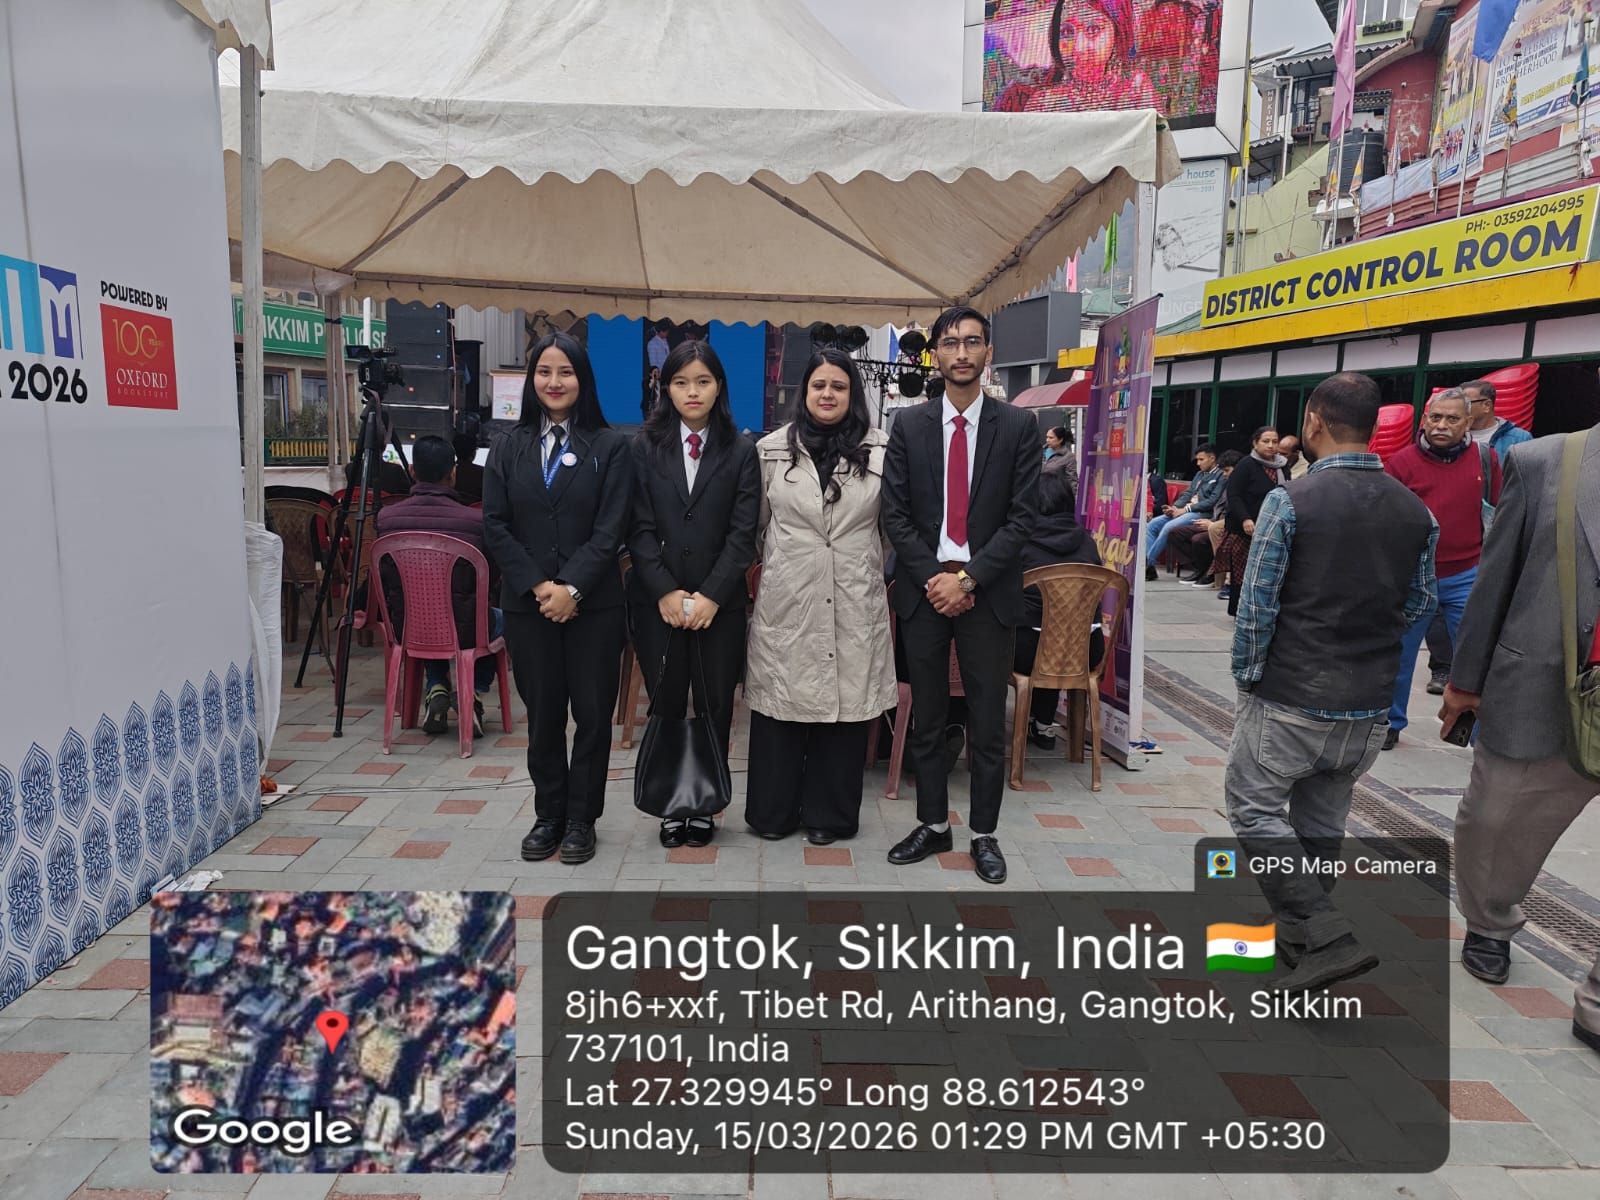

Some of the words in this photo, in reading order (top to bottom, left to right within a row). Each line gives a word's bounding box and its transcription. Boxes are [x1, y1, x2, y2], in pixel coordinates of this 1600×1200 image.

[1495, 50, 1558, 88] BROHERHOOD
[1494, 194, 1584, 228] 03592204995
[1206, 276, 1301, 318] DISTRICT
[1306, 247, 1444, 300] CONTROL
[1453, 214, 1583, 274] ROOM
[100, 280, 153, 308] POWERED
[155, 294, 168, 312] BY
[112, 318, 158, 360] 100
[263, 315, 310, 343] IKKIM
[8, 360, 88, 404] 2026
[116, 367, 168, 389] OXFORD
